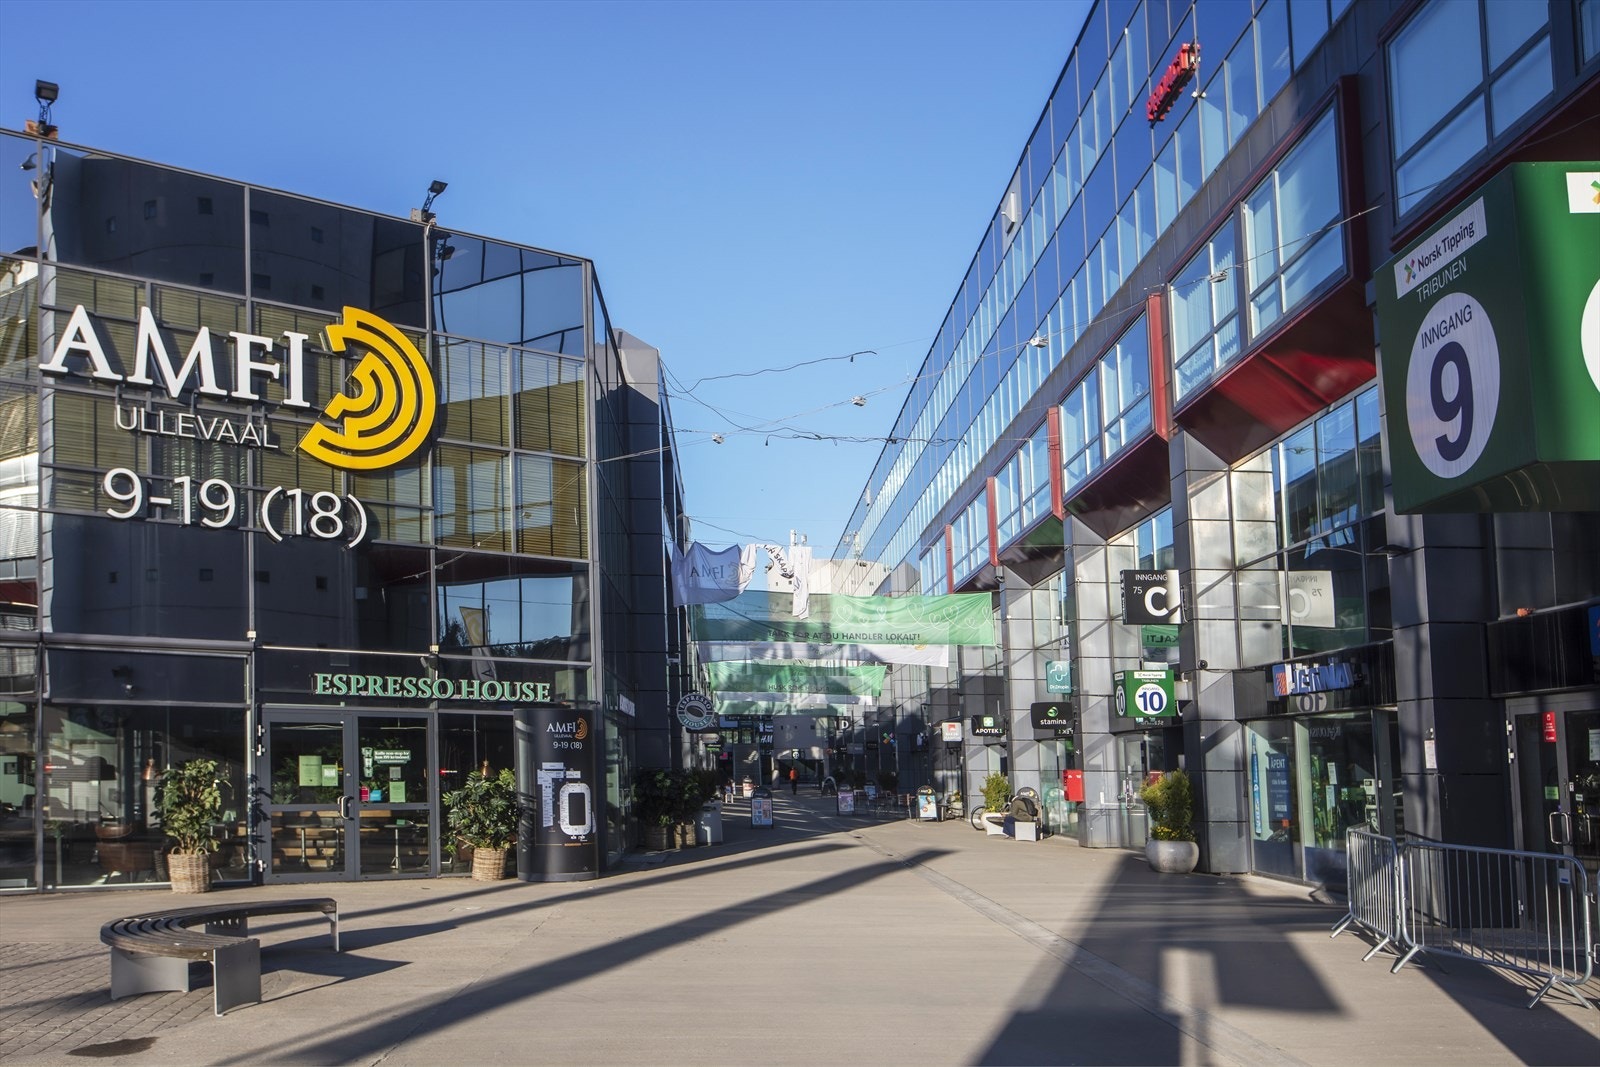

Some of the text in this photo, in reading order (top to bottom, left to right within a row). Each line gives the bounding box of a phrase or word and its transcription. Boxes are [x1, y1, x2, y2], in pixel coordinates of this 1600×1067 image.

[1416, 220, 1475, 272] Norsk Tipping
[1416, 257, 1468, 303] TRIBUNEN
[1421, 304, 1473, 349] INNGANG
[39, 304, 311, 408] AMFI
[1430, 341, 1474, 462] 9
[115, 404, 279, 449] ULLEVAAL
[103, 467, 367, 550] 9-19 (18)
[1133, 586, 1143, 594] 75
[1144, 586, 1169, 617] C
[886, 633, 920, 641] LOKALT!
[314, 673, 551, 702] ESPRESSO HOUSE
[1138, 691, 1164, 712] 10
[680, 695, 711, 710] ESPRESSO
[546, 721, 576, 733] AMFI
[841, 720, 849, 729] D
[552, 741, 583, 750] 9-19 (18)
[1270, 757, 1286, 769] ÅPENT
